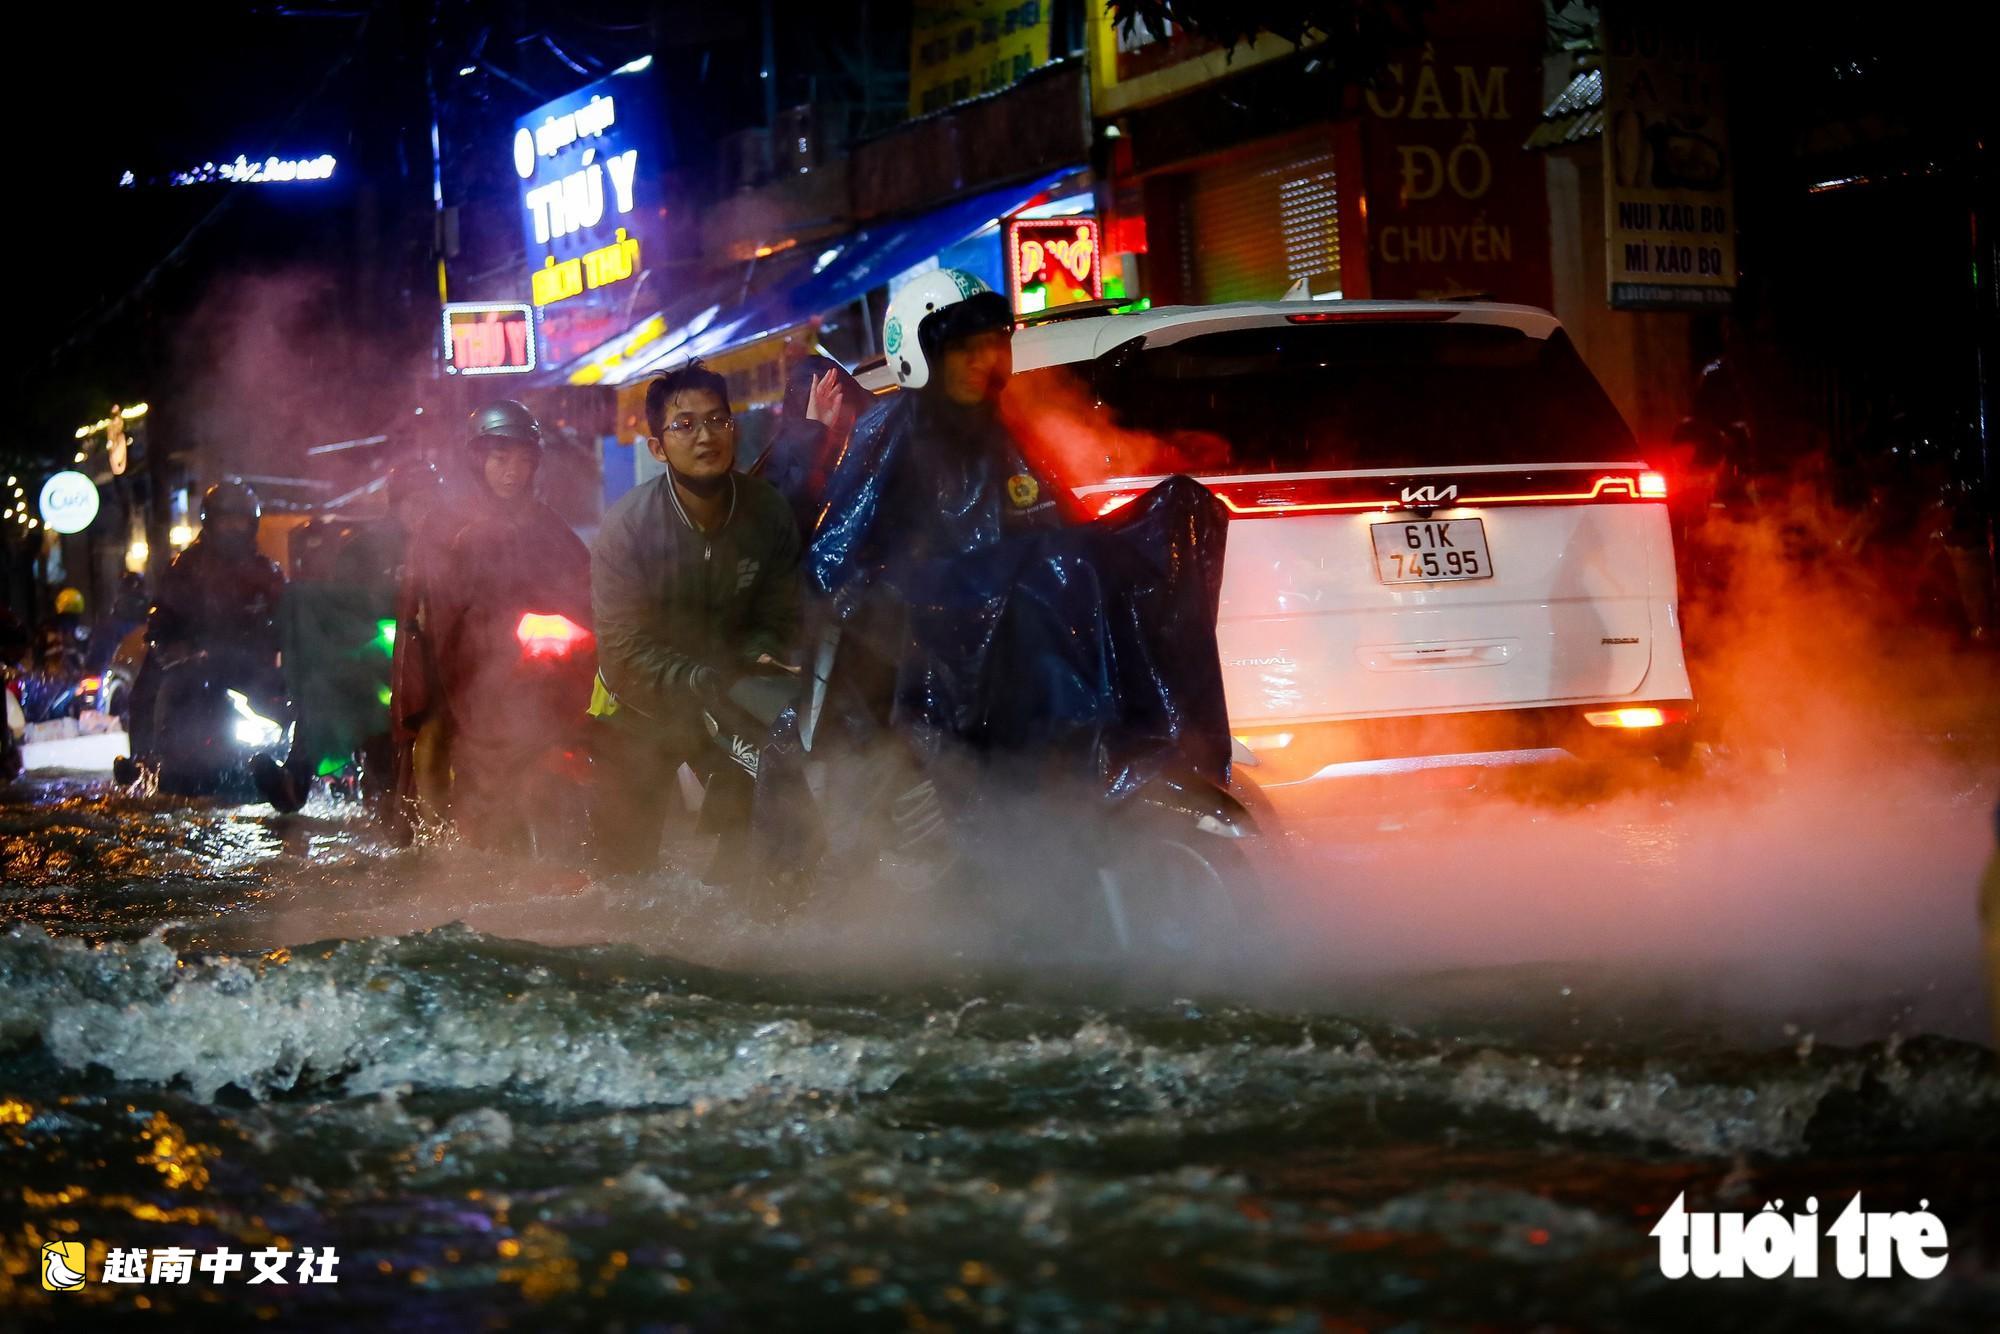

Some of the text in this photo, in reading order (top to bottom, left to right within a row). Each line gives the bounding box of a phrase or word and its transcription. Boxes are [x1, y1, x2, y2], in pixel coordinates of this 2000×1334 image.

[1396, 122, 1493, 201] ĐỒ
[526, 148, 638, 244] THÚ Y
[1405, 523, 1454, 549] 61K
[1390, 551, 1479, 578] 745.95
